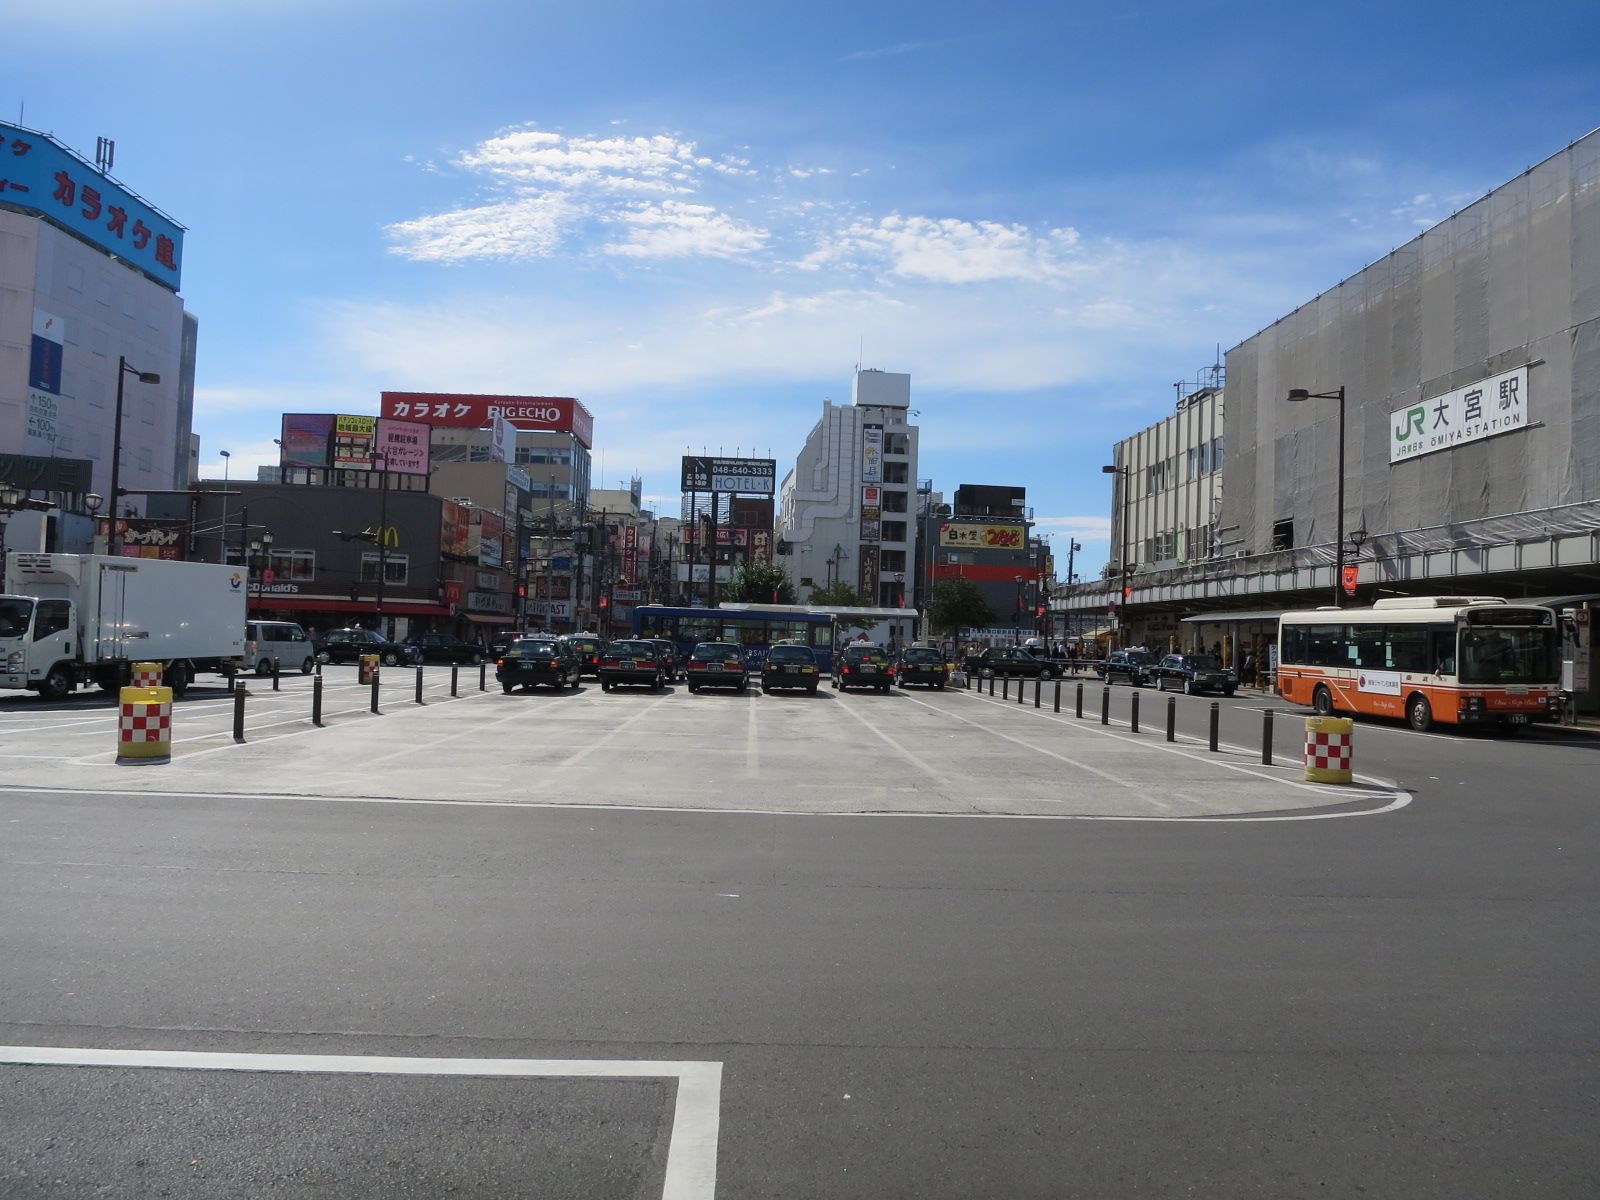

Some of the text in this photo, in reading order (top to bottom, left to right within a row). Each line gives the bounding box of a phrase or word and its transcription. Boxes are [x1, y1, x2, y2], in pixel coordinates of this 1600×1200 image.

[54, 171, 178, 271] カラオケ館
[393, 402, 471, 419] カラオケ
[1433, 376, 1519, 430] 大宮駅
[487, 405, 561, 421] BIG ECHO
[1396, 406, 1425, 441] JR
[1466, 413, 1520, 437] STATION
[1396, 442, 1424, 457] JR東日本
[712, 466, 773, 476] 048-640-3333
[247, 583, 299, 593] cDonald's
